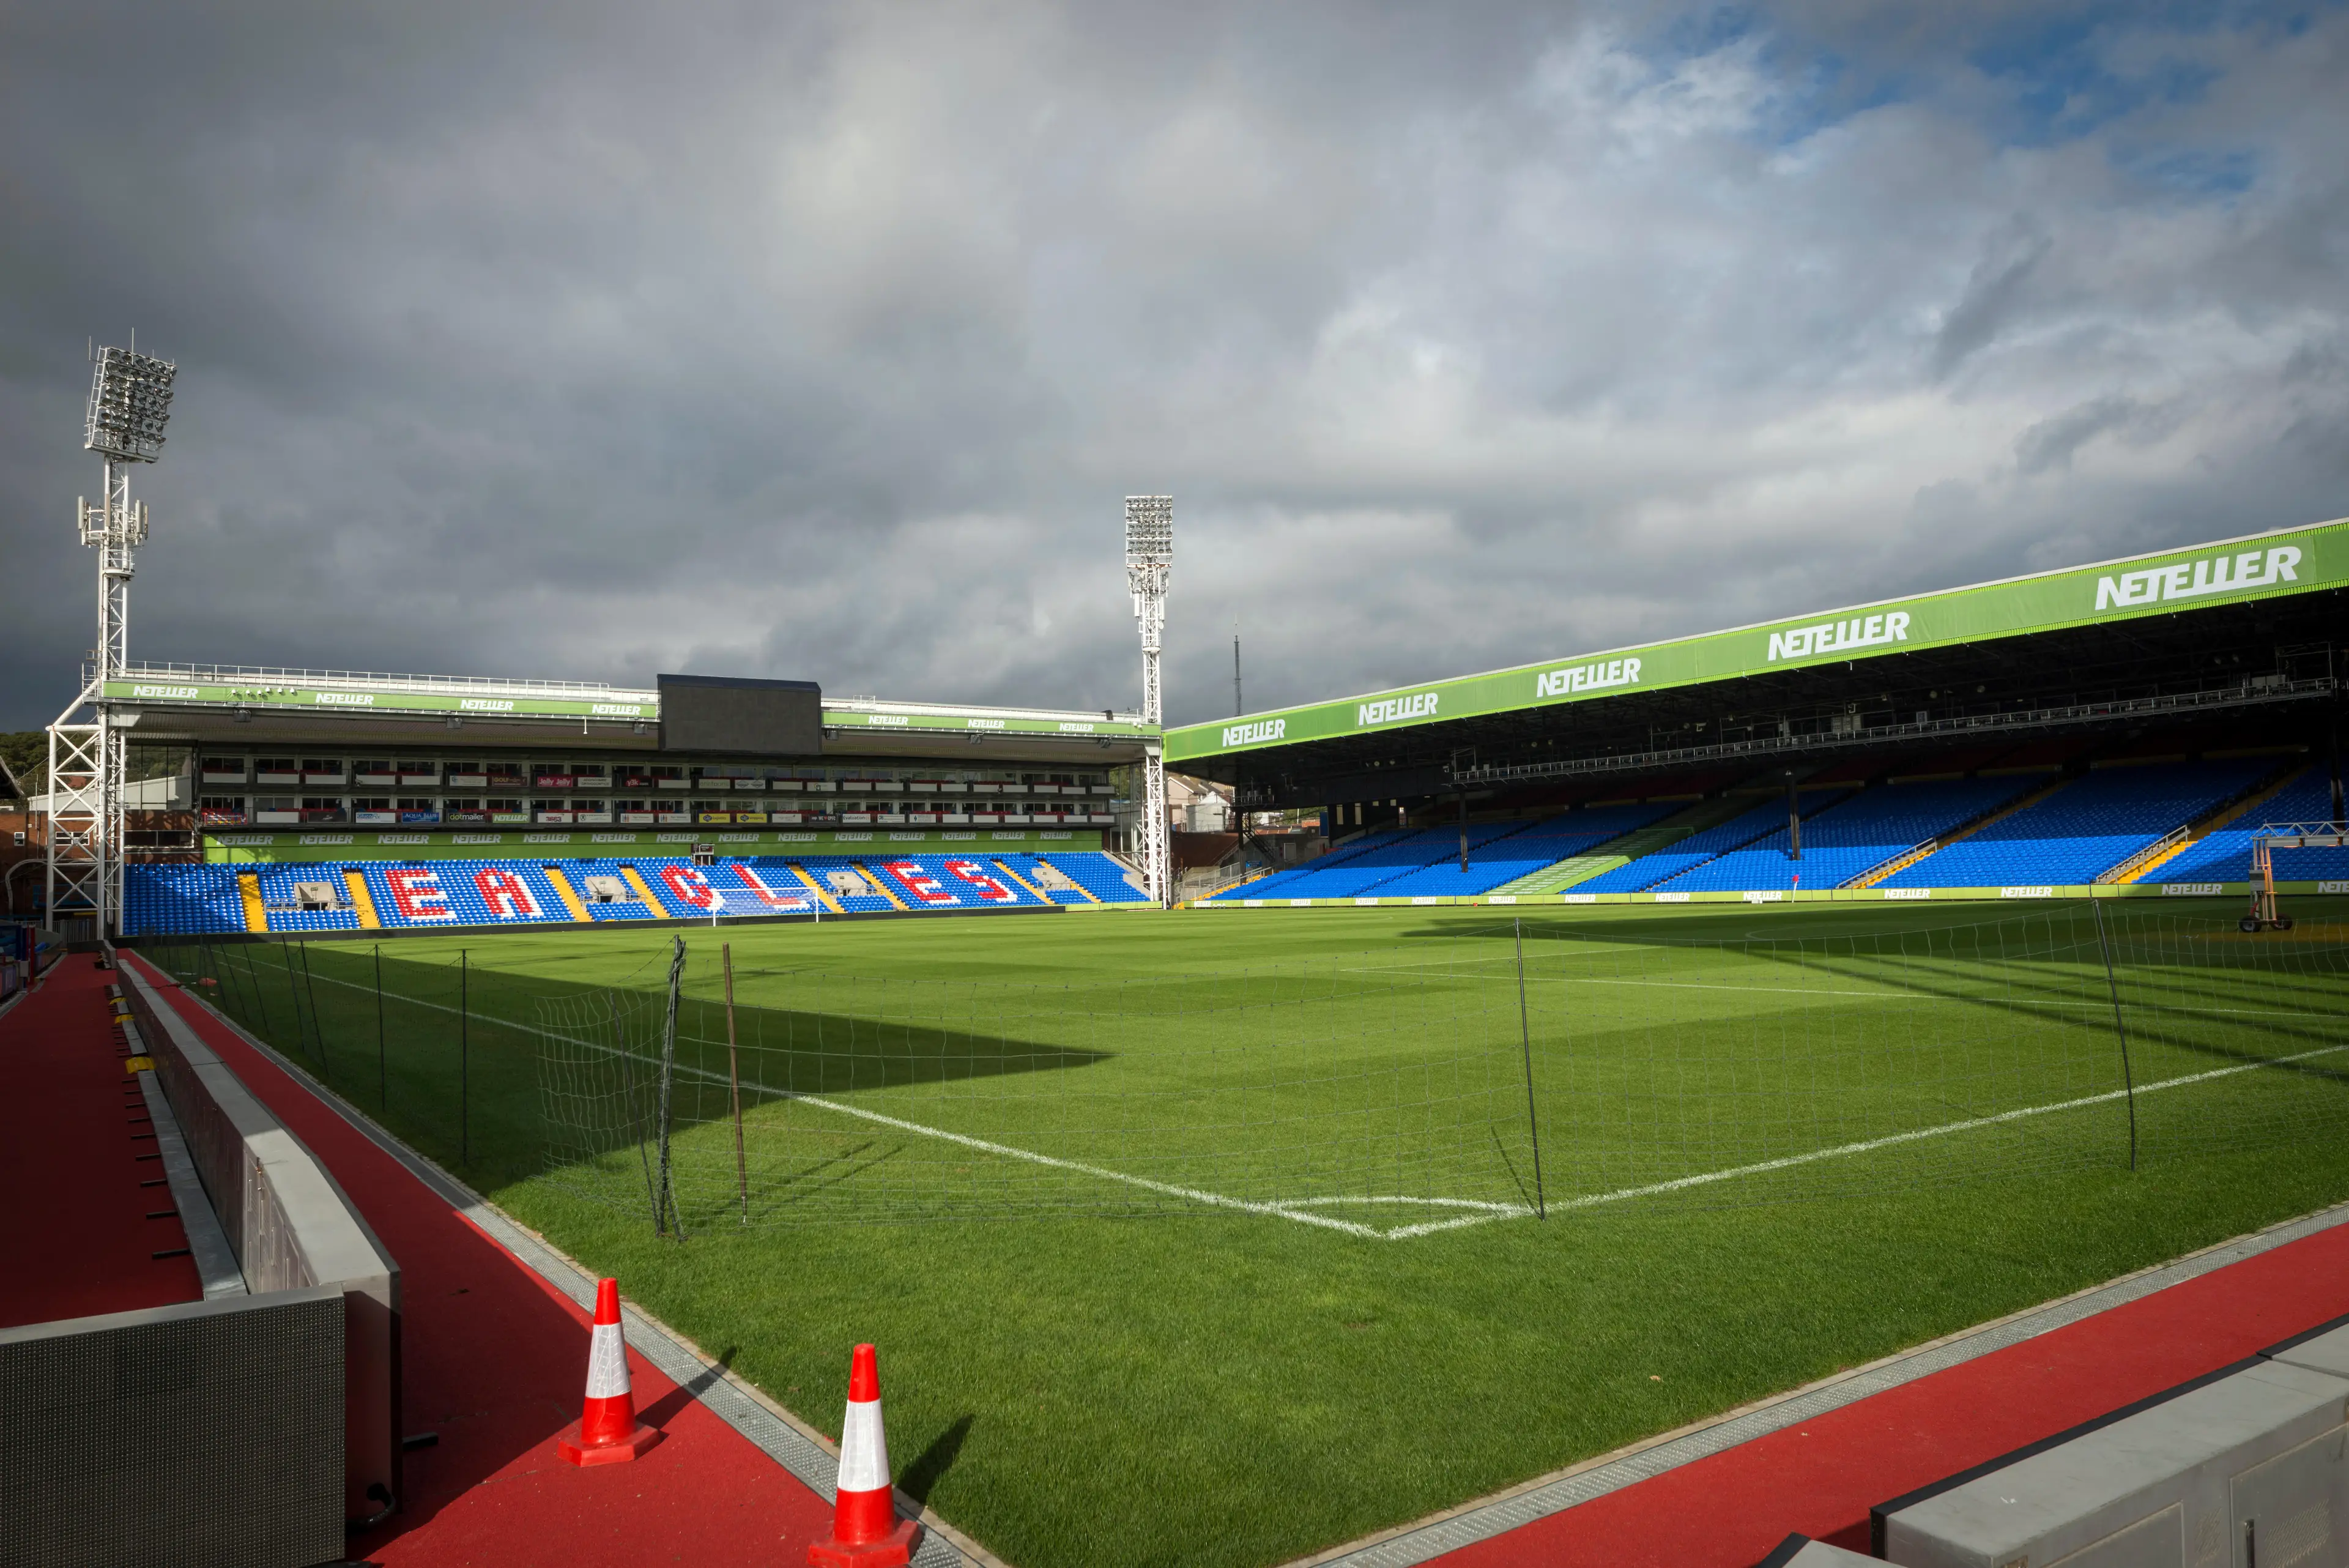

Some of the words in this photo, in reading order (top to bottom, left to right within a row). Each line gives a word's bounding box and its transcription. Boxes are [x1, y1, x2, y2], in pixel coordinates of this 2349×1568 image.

[2095, 545, 2303, 611] NETELLER
[1767, 611, 1910, 661] NETELLER
[1536, 657, 1642, 698] NETELLER
[133, 686, 198, 698] NETELLER
[316, 693, 374, 705] NETELLER
[461, 699, 514, 710] NETELLER
[1357, 692, 1439, 726] NETELLER
[592, 705, 640, 715] NETELLER
[869, 716, 908, 725] NETELLER
[968, 719, 1004, 729] NETELLER
[1059, 723, 1094, 732] NETELLER
[1222, 718, 1286, 748] NETELLER
[216, 834, 274, 846] NETELLER
[299, 836, 353, 844] NETELLER
[378, 835, 429, 844] NETELLER
[452, 835, 501, 844] NETELLER
[591, 834, 636, 842] NETELLER
[656, 834, 699, 843] NETELLER
[889, 833, 925, 841] NETELLER
[1885, 888, 1932, 899] NETELLER
[2001, 886, 2052, 897] NETELLER
[2162, 883, 2222, 894] NETELLER
[1488, 896, 1516, 904] NETELLER
[1655, 893, 1690, 901] NETELLER
[1743, 891, 1782, 901] NETELLER
